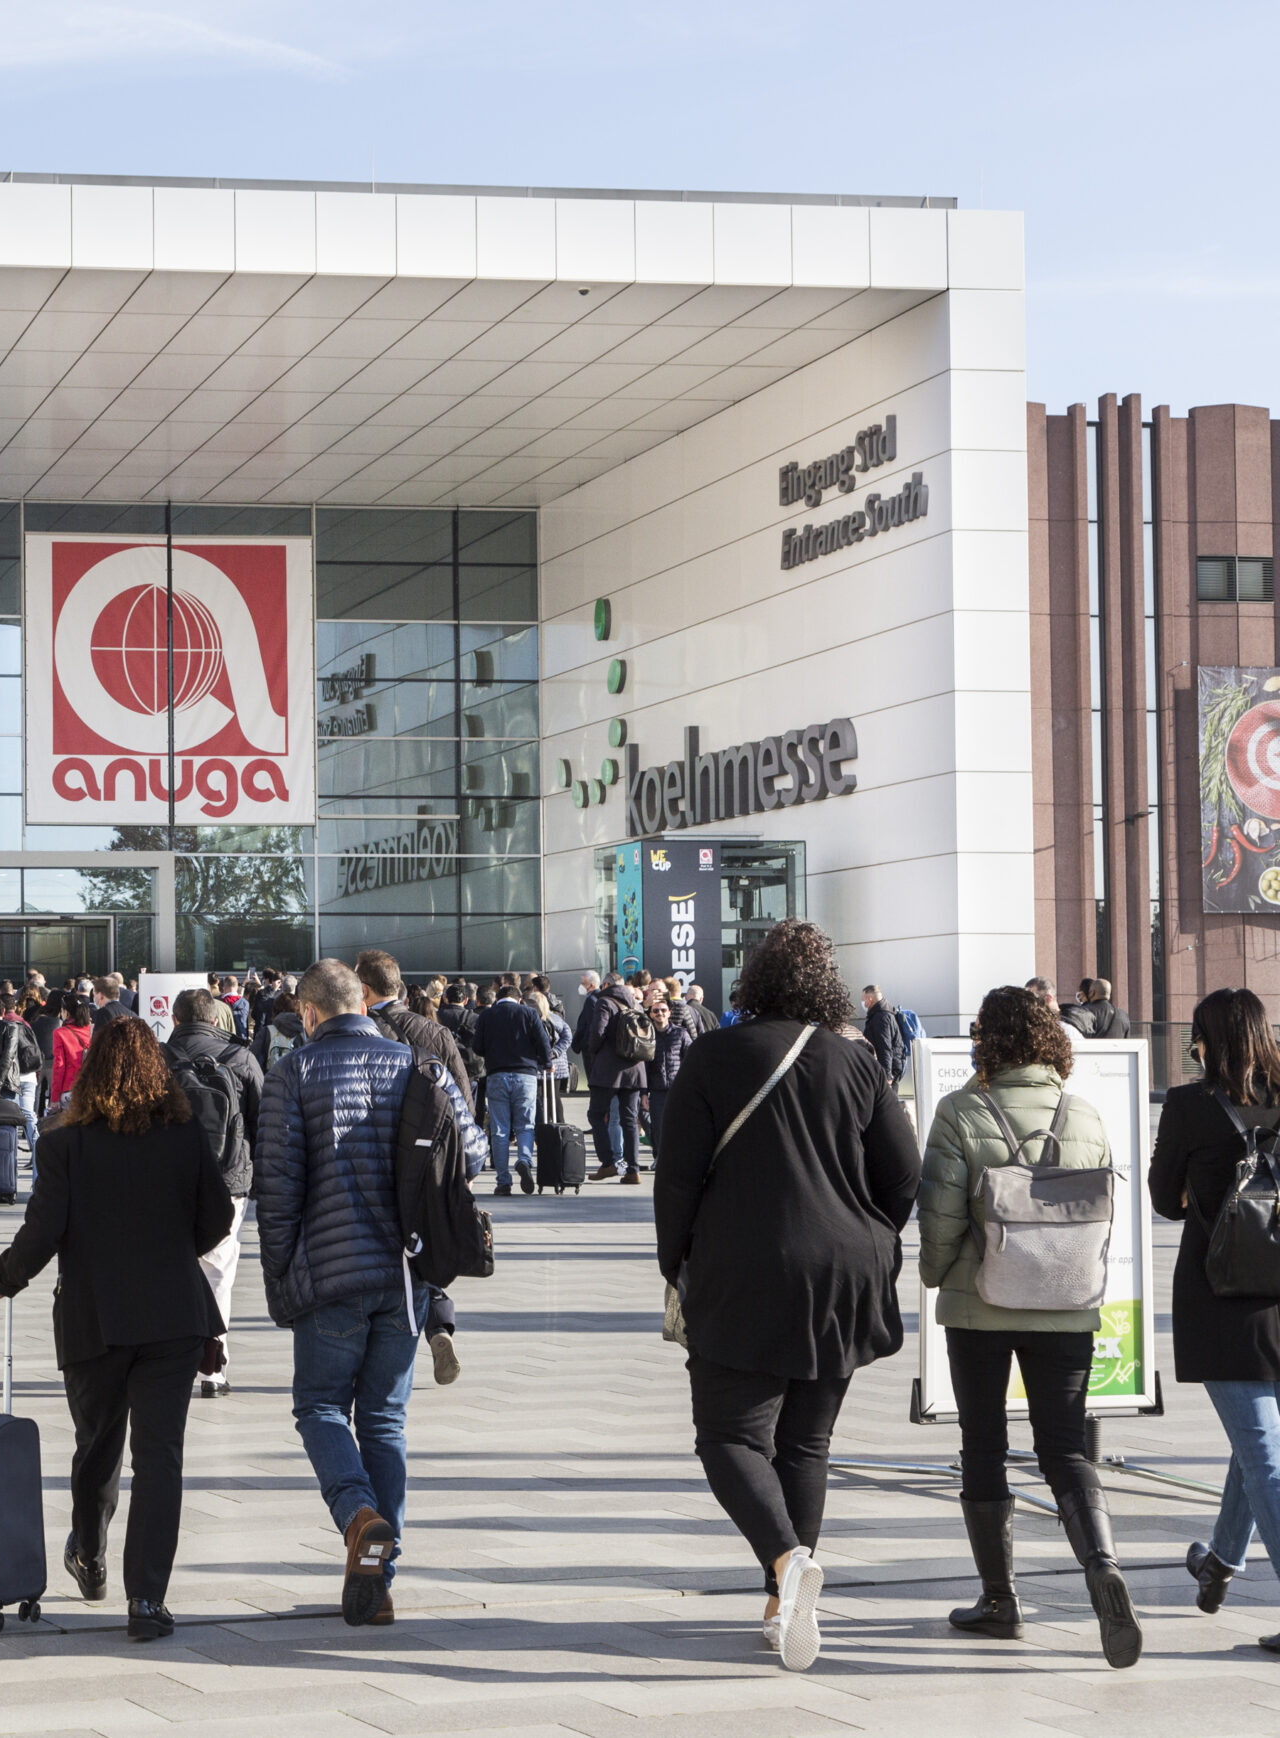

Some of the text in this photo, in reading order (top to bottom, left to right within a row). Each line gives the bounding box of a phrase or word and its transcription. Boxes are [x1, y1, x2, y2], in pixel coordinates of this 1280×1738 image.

[779, 414, 897, 507] Eingang Süd
[781, 472, 929, 570] Entrance South
[52, 757, 290, 818] anuga
[625, 718, 858, 837] koelnmesse
[650, 849, 667, 863] WE
[652, 861, 671, 871] CUP
[671, 899, 696, 993] RESE
[938, 1068, 969, 1078] CH3CK
[939, 1083, 965, 1093] Zutri
